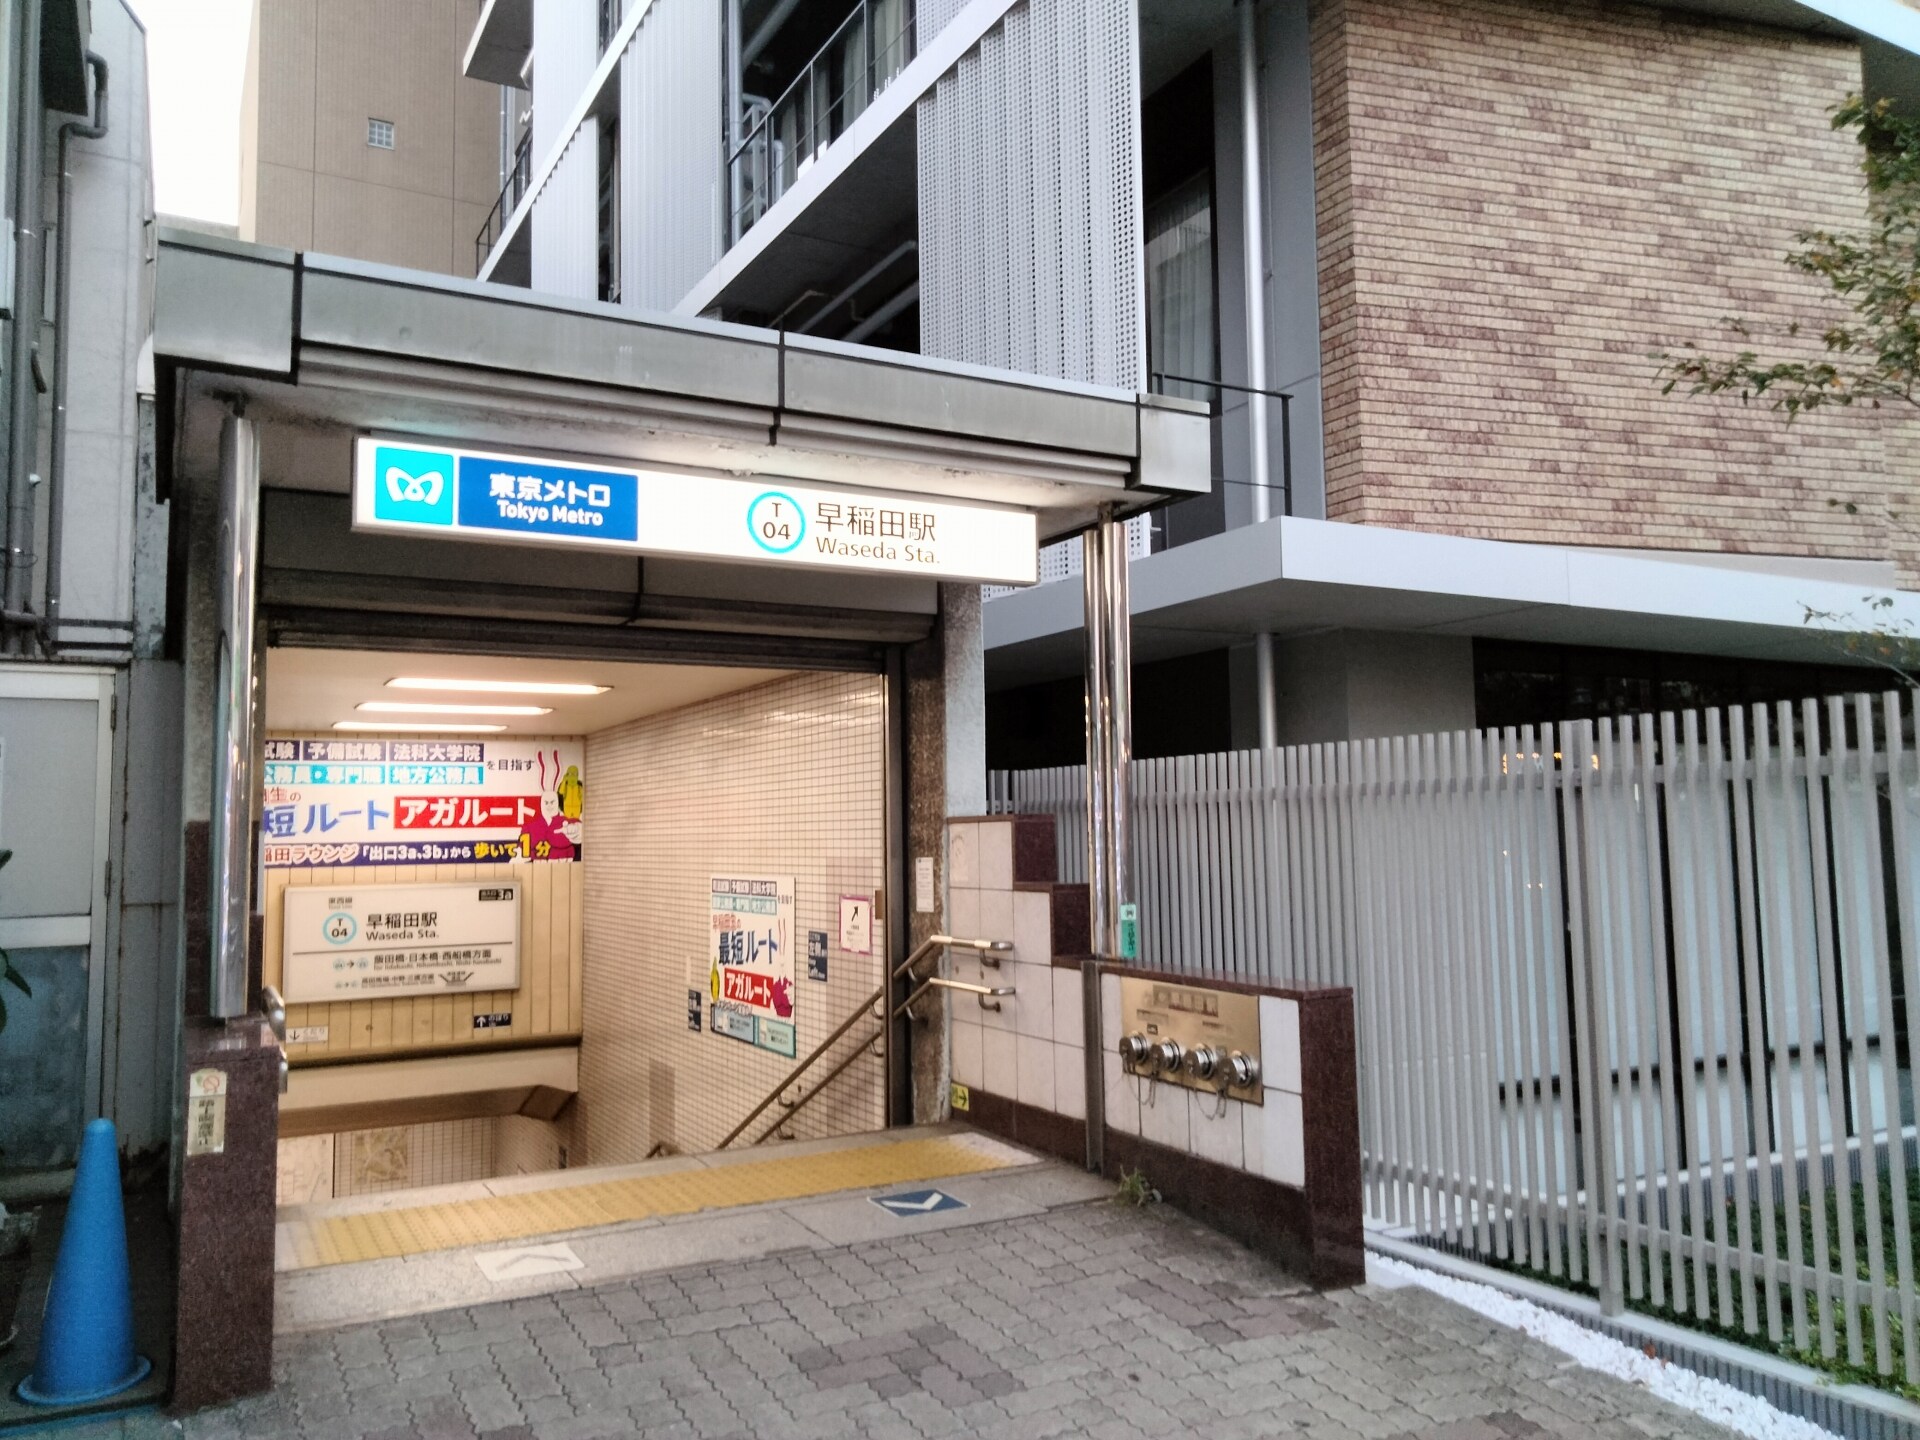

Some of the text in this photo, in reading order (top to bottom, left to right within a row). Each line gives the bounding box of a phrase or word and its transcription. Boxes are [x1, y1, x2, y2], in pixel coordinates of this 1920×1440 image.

[489, 473, 611, 507] 東京メトロ
[497, 499, 604, 526] Tokyo Metro
[771, 502, 782, 518] T
[762, 521, 791, 540] 04
[815, 502, 937, 542] 早稲田駅
[815, 536, 941, 565] Waseda Sta.
[308, 742, 382, 760] 予備試験
[394, 743, 481, 761] 法科大学院
[486, 759, 535, 771] を目指す
[399, 797, 536, 827] アガルート
[366, 911, 438, 929] 早稲田駅
[331, 928, 348, 938] 04
[366, 928, 440, 941] Waseda Sta.
[718, 928, 777, 966] 最短ルート
[726, 972, 771, 1006] アガルート
